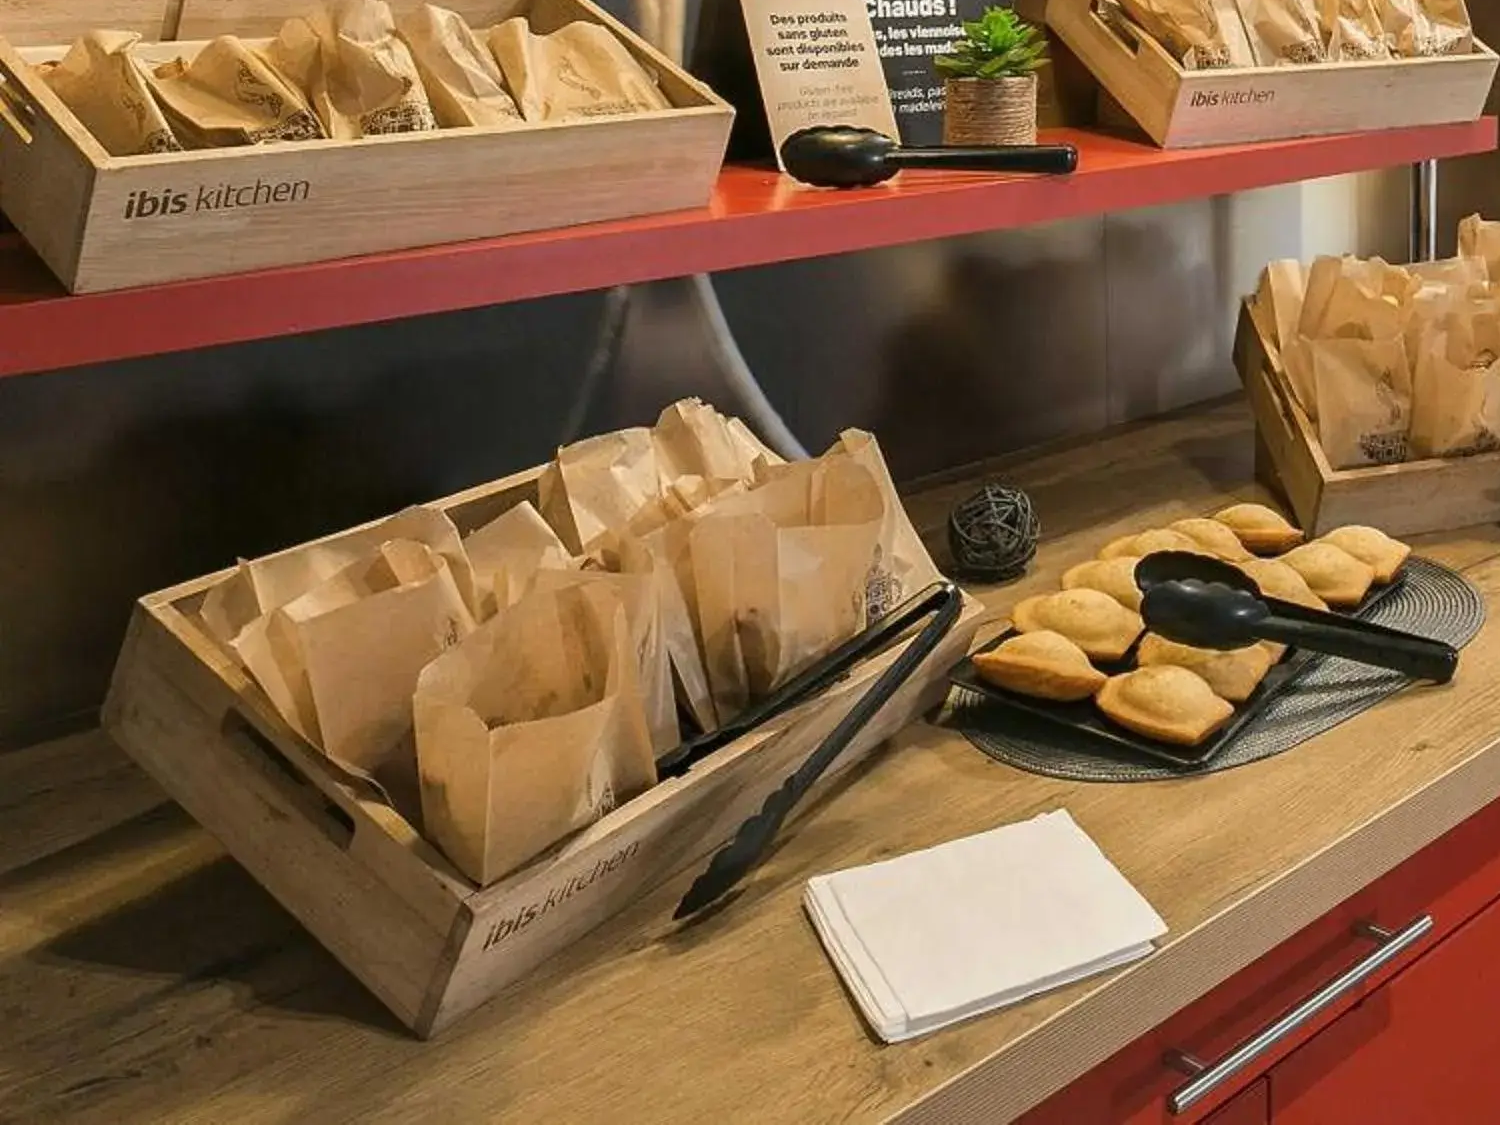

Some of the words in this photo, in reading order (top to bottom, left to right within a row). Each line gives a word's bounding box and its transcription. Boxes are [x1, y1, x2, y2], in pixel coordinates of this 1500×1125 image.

[769, 14, 795, 25] Des
[797, 12, 848, 27] produits
[777, 30, 808, 40] sans
[809, 27, 848, 42] gluten
[765, 45, 794, 57] sont
[796, 41, 865, 57] disponibles
[779, 61, 801, 72] sur
[802, 56, 860, 70] demande
[1190, 90, 1219, 108] ibis
[1221, 85, 1275, 107] kitchen
[123, 188, 188, 219] ibis
[195, 178, 311, 212] kitchen
[483, 903, 540, 953] ibis
[540, 840, 640, 916] kitchen
